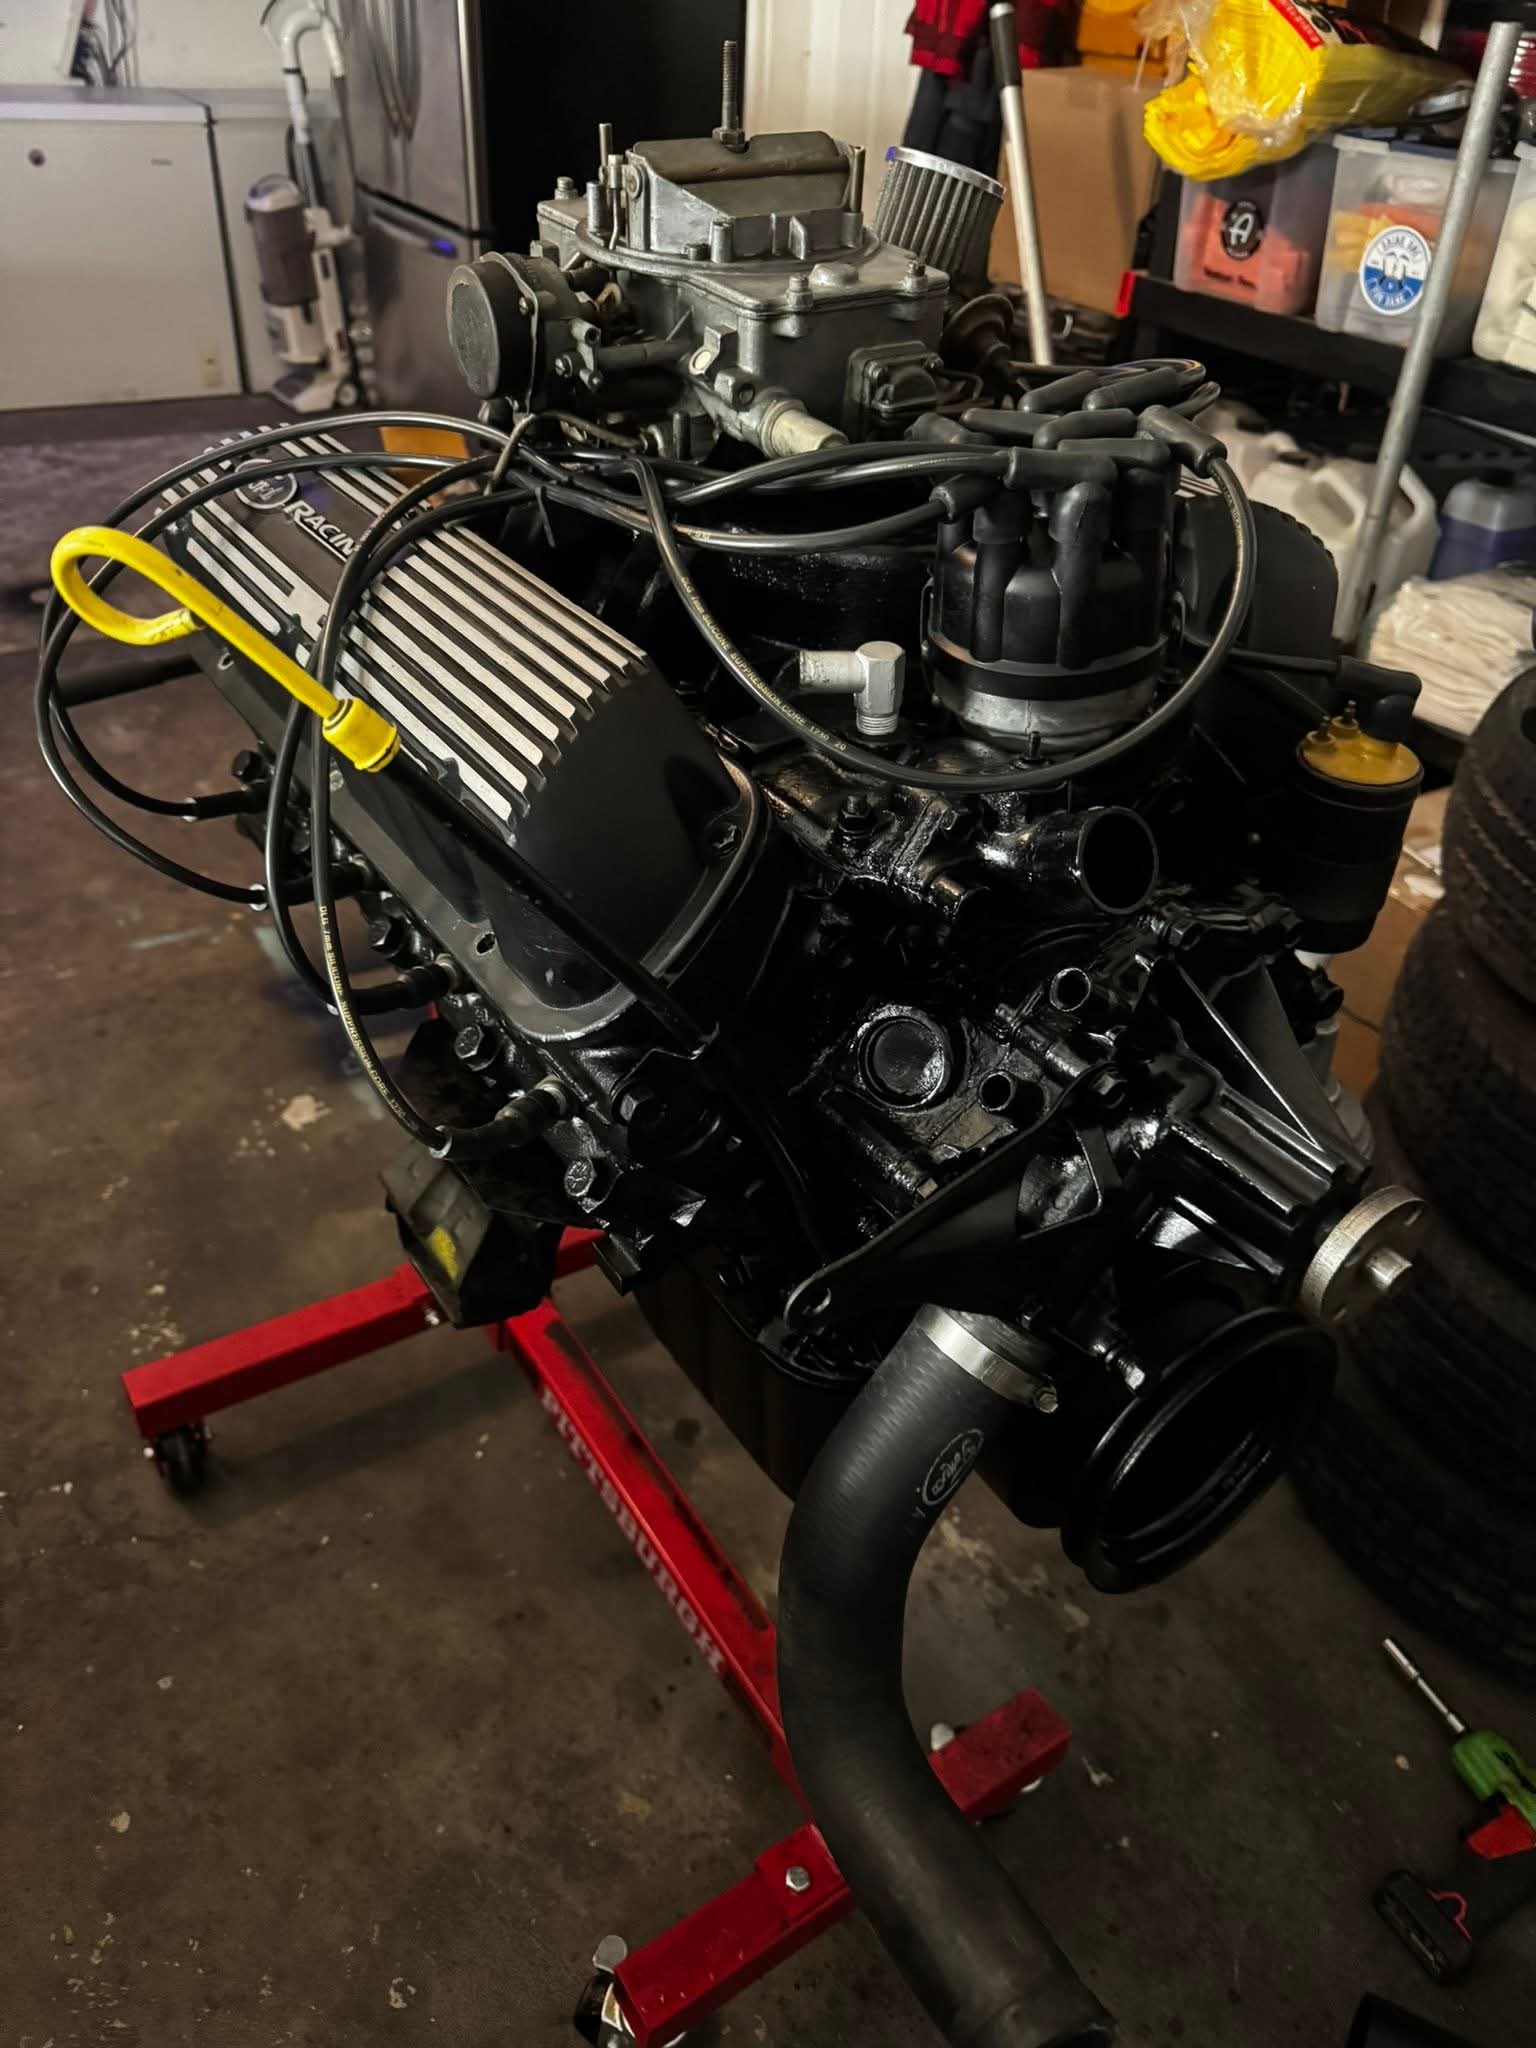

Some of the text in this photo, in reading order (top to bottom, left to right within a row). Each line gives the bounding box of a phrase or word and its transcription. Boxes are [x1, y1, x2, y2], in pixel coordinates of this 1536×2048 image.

[283, 500, 357, 557] RACIN
[702, 613, 730, 650] SILICONE
[729, 651, 782, 707] SUPPRESSION
[781, 704, 807, 727] CORE
[369, 1069, 389, 1097] CORE
[540, 1386, 726, 1675] PITTSBURGH
